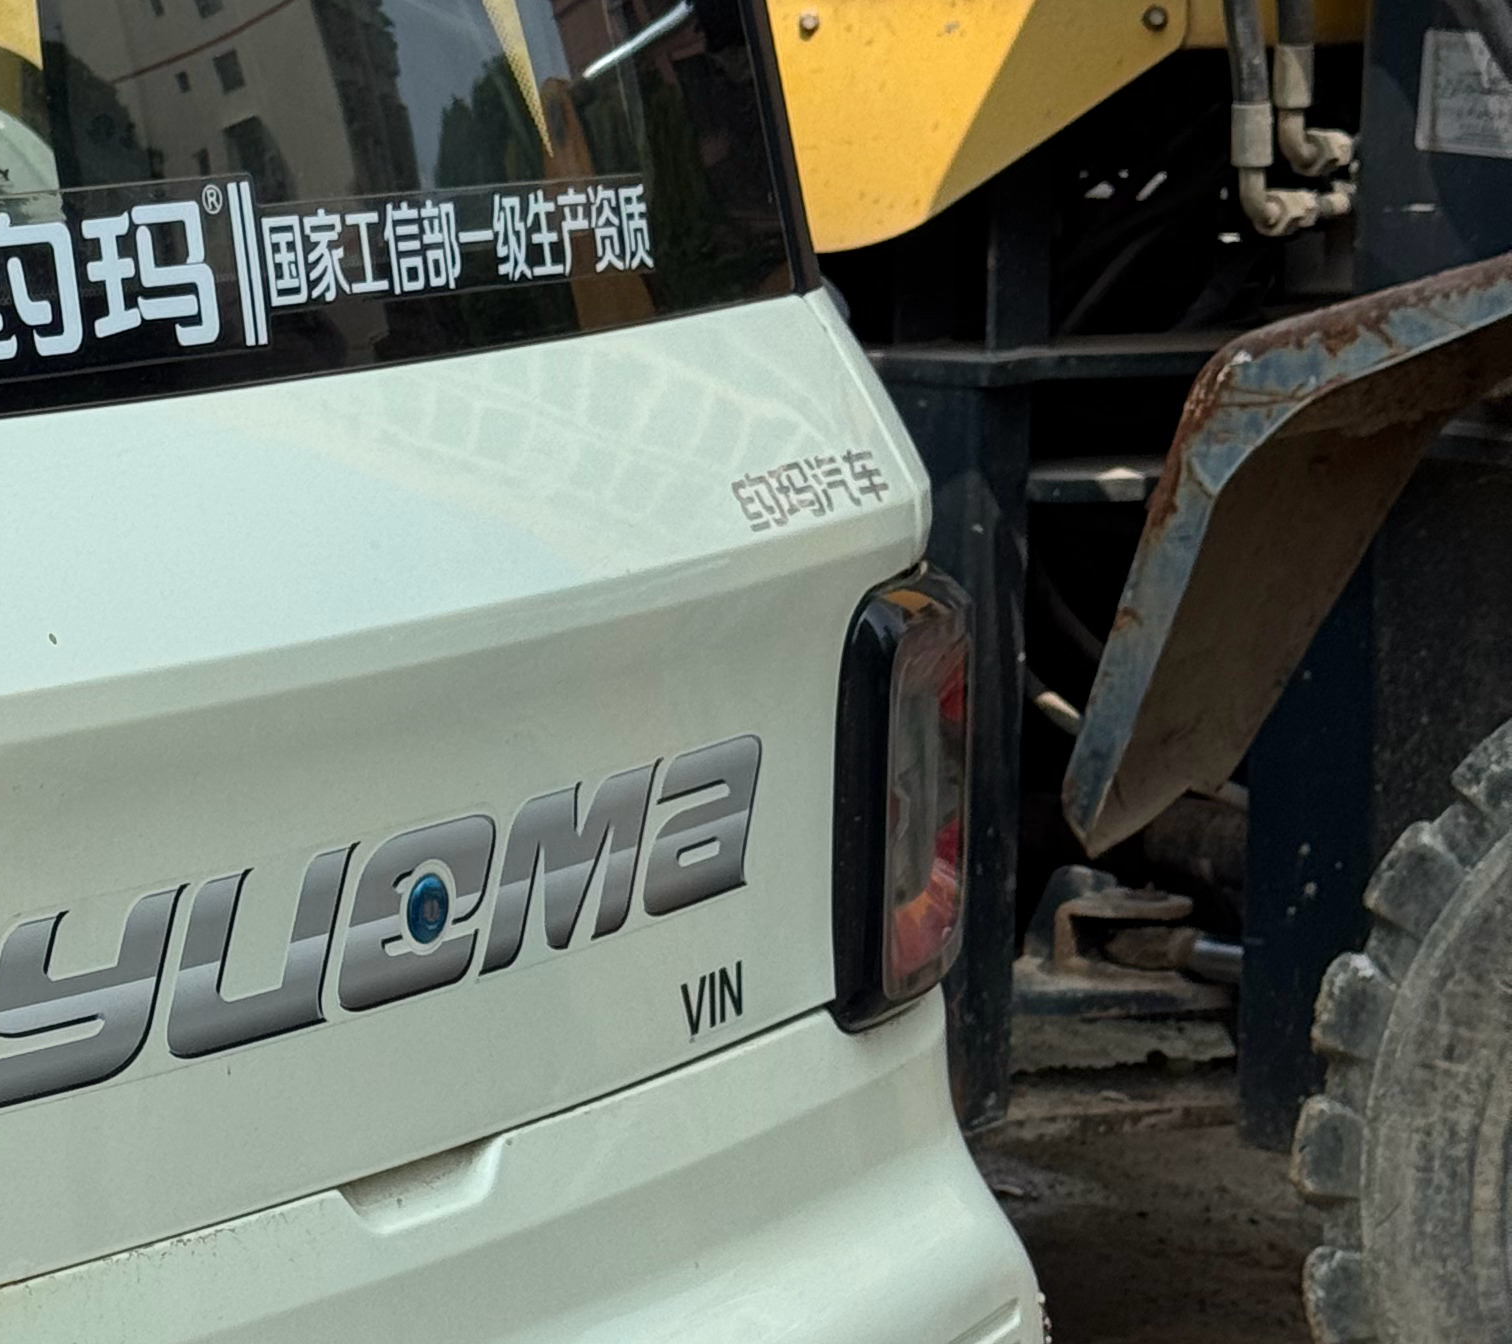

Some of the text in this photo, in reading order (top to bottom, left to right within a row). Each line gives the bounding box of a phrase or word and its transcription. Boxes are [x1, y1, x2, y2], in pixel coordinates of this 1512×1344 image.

[260, 183, 655, 308] 国家工信部一级生产资质
[679, 959, 745, 1041] VIN
